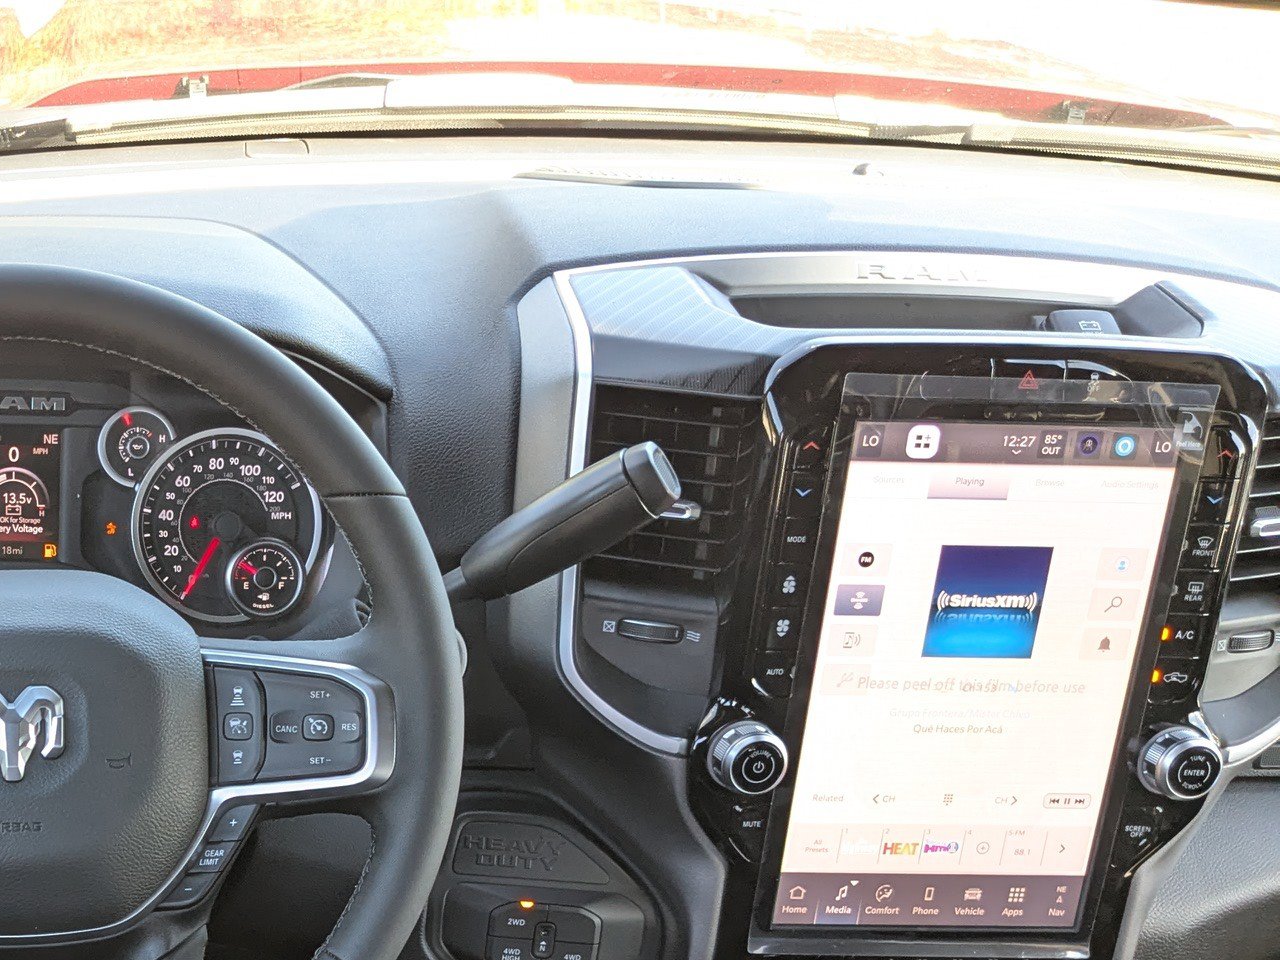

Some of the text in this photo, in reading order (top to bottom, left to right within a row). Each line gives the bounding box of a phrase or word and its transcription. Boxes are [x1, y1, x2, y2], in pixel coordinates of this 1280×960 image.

[43, 434, 58, 444] NE
[158, 435, 166, 443] H
[862, 436, 879, 447] LO
[1003, 435, 1036, 448] 12:27
[1044, 434, 1062, 444] 85°
[32, 447, 48, 455] MPH
[1042, 447, 1061, 455] OUT
[1155, 442, 1171, 453] LO
[8, 446, 20, 462] 0
[208, 458, 224, 470] 80
[229, 458, 240, 466] 90
[128, 468, 134, 477] L
[239, 465, 261, 476] 100
[175, 476, 190, 487] 60
[262, 476, 275, 484] 110
[955, 477, 984, 486] Playing
[1035, 479, 1065, 487] Browse
[3, 492, 32, 504] 13.5v
[166, 492, 176, 500] 50
[263, 491, 285, 502] 120
[158, 510, 174, 521] 40
[271, 512, 292, 520] MPH
[18, 517, 41, 526] Storage
[12, 524, 44, 535] Voltage
[158, 530, 168, 538] 30
[164, 545, 179, 556] 20
[173, 565, 182, 573] 10
[244, 582, 250, 590] E
[278, 582, 285, 590] F
[1184, 594, 1203, 602] REAR
[1175, 630, 1194, 640] A/C
[766, 668, 784, 676] AUTO
[857, 676, 899, 689] Please
[903, 678, 931, 692] peel
[935, 678, 956, 691] off
[1015, 680, 1058, 693] before
[1063, 682, 1086, 694] use
[275, 724, 298, 734] CANC
[341, 722, 357, 731] RES
[936, 724, 965, 734] Haces
[967, 724, 984, 734] Por
[750, 750, 772, 759] VOLUME
[1182, 782, 1202, 790] SCROLL
[812, 794, 844, 802] Related
[882, 795, 896, 803] CH
[994, 796, 1008, 804] CH
[463, 835, 568, 856] HEAVY
[882, 842, 920, 856] HEAT
[204, 849, 225, 858] GEAR
[199, 858, 219, 866] LIMIT
[475, 854, 557, 871] DUTY
[1056, 886, 1067, 894] NE
[782, 906, 807, 914] Home
[826, 906, 852, 914] Media
[865, 906, 900, 915] Comfort
[912, 907, 940, 916] Phone
[954, 907, 985, 916] Vehicle
[1002, 908, 1024, 918] Apps
[1048, 908, 1066, 916] Nav
[508, 918, 526, 926] 2WD
[502, 948, 521, 956] 4WD
